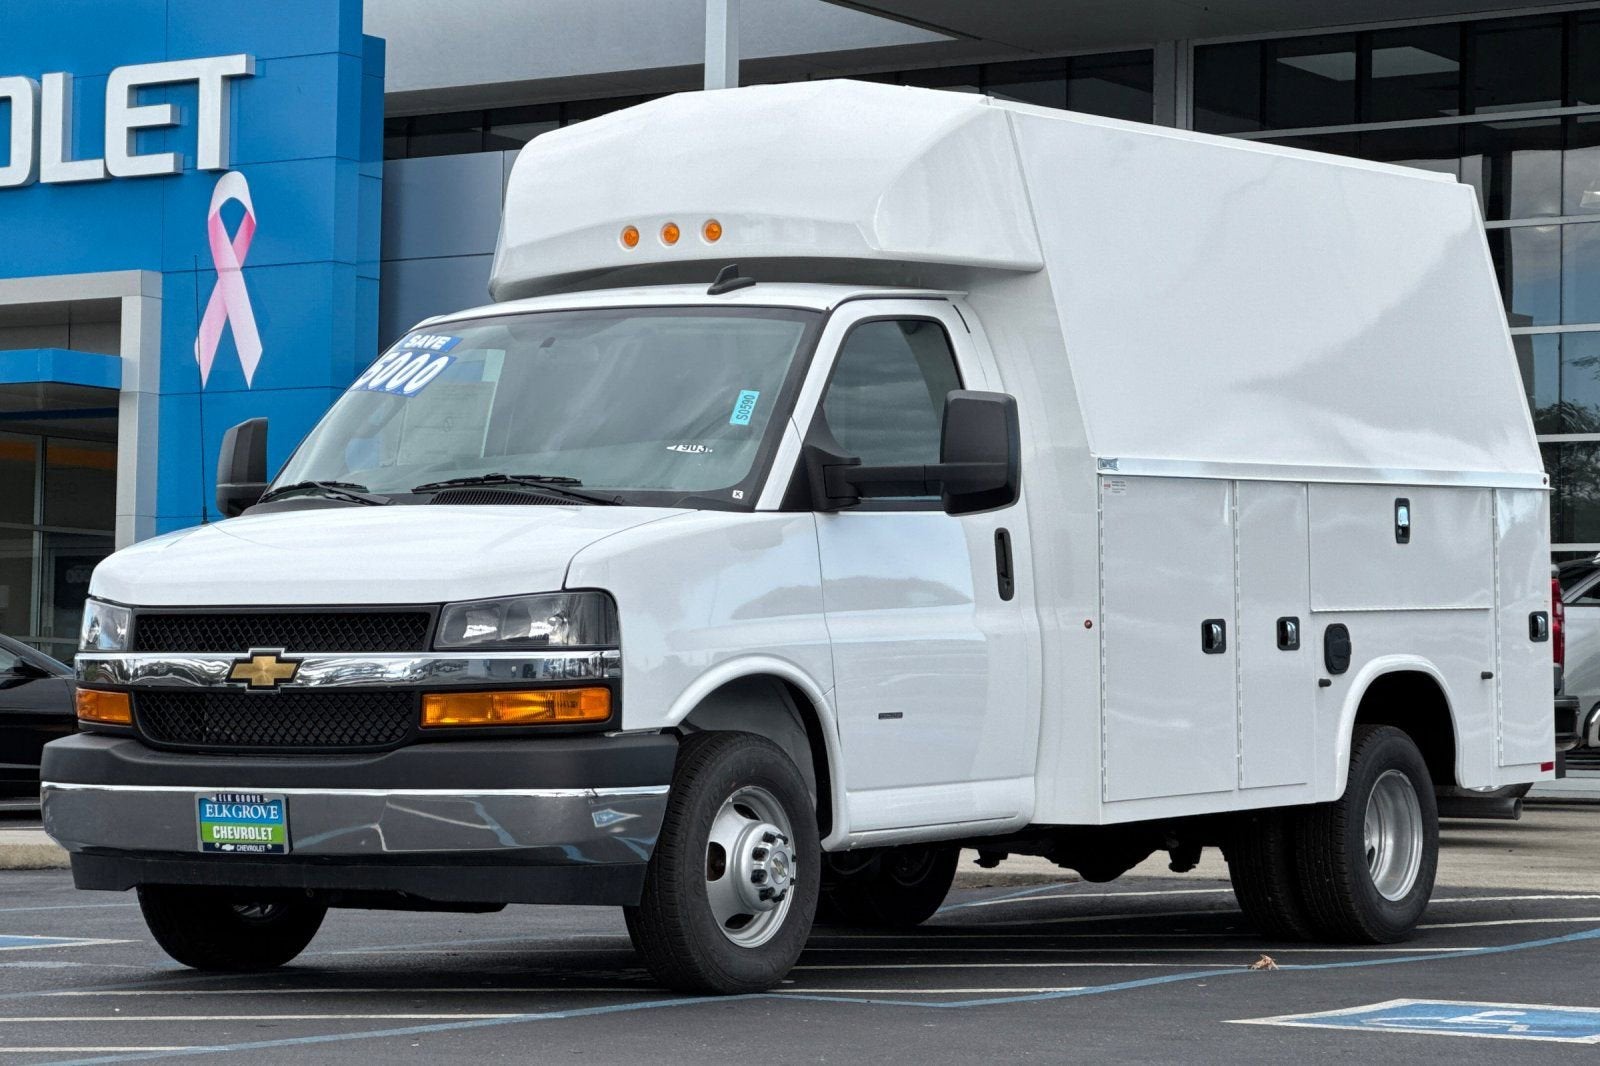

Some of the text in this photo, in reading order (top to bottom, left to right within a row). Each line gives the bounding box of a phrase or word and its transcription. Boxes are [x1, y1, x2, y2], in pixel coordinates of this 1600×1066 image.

[403, 334, 452, 350] SAVE
[218, 794, 232, 803] ELK
[213, 825, 273, 841] CHEVROLET
[236, 844, 266, 853] CHEVROLET
